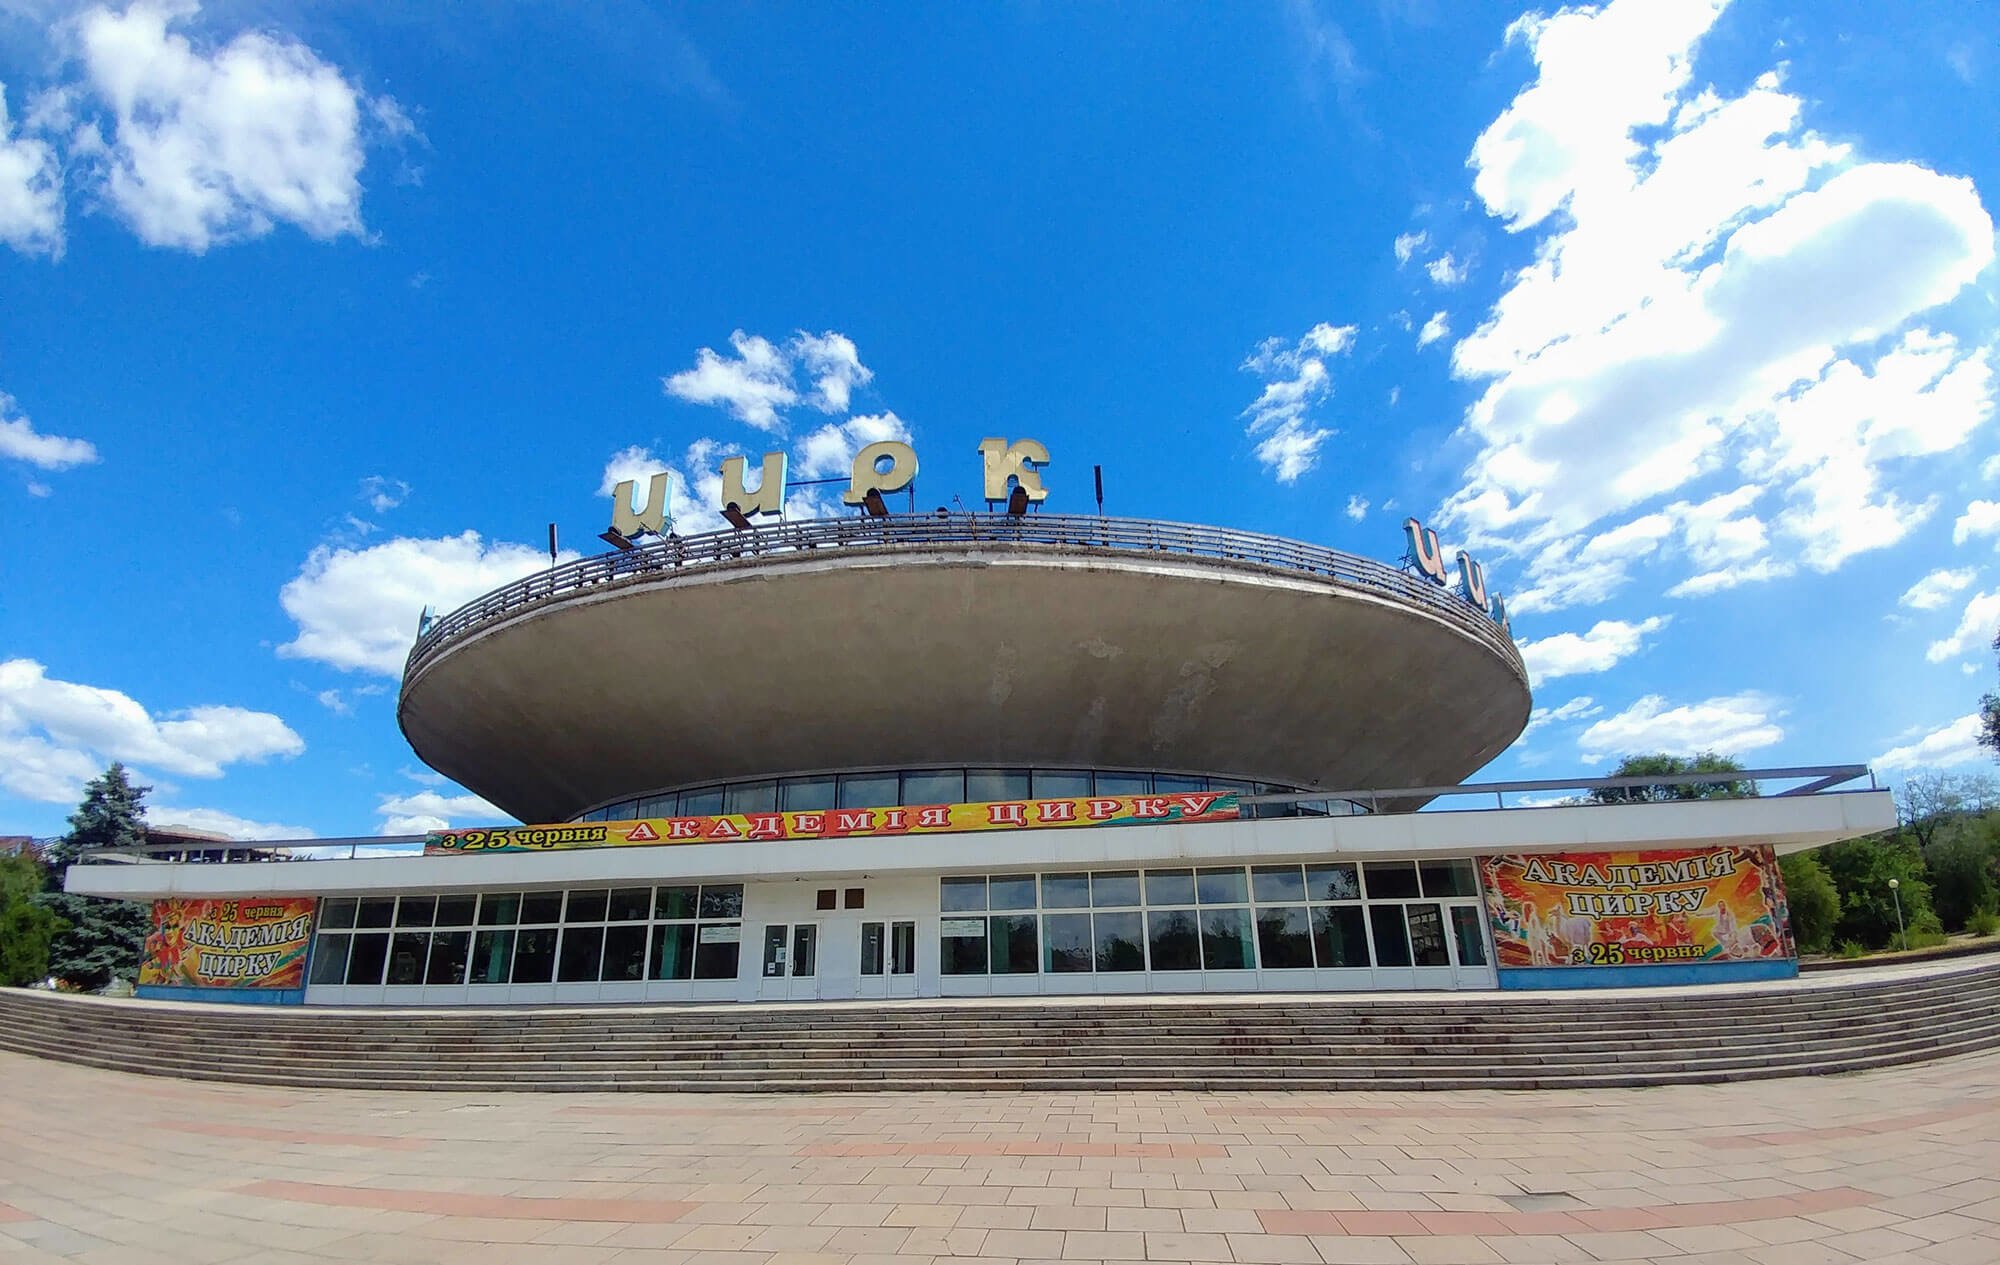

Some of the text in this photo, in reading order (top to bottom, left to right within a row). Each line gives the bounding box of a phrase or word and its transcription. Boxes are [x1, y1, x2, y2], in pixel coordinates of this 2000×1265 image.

[462, 830, 508, 850] 25
[515, 826, 606, 846] червня
[626, 808, 951, 841] АКАДЕМІЯ
[989, 794, 1217, 826] ЦИРКУ
[1523, 851, 1735, 889] АКАДЕМІЯ
[221, 902, 239, 922] 25
[244, 906, 284, 919] червня
[1567, 887, 1708, 919] ЦИРКУ
[185, 917, 308, 950] АКАДЕМІЯ
[199, 951, 281, 979] ЦИРКУ
[1590, 944, 1624, 964] 25
[1627, 944, 1705, 959] червня
